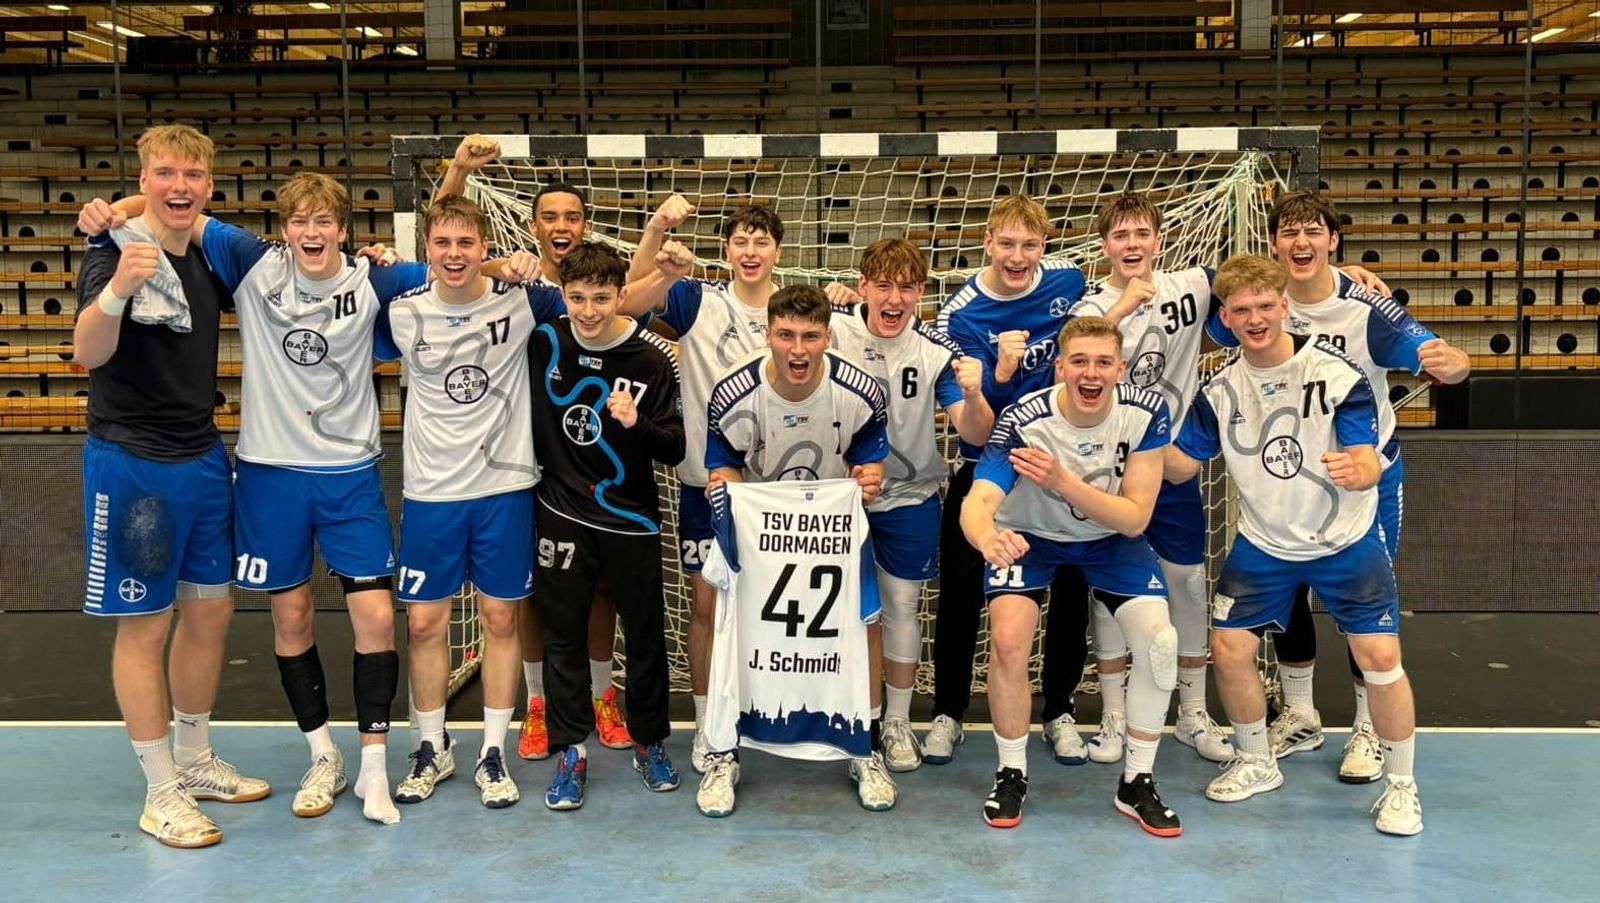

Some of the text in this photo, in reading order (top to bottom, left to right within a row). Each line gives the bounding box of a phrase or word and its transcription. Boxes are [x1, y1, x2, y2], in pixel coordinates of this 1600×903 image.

[333, 290, 358, 320] 10
[1161, 293, 1197, 335] 30
[486, 316, 511, 346] 17
[286, 340, 325, 354] BAYER
[448, 379, 486, 391] BAYER
[461, 368, 473, 401] BAYER
[901, 367, 918, 400] 6
[566, 417, 599, 433] BAYER
[577, 408, 588, 442] BAYER
[1278, 440, 1290, 475] BAYER
[761, 511, 853, 533] TSV BAYER
[538, 537, 576, 570] 97
[758, 533, 852, 555] DORMAGEN
[237, 553, 268, 584] 10
[398, 565, 426, 595] 17
[988, 563, 1025, 588] 31
[760, 563, 843, 638] 42
[748, 648, 764, 671] J.
